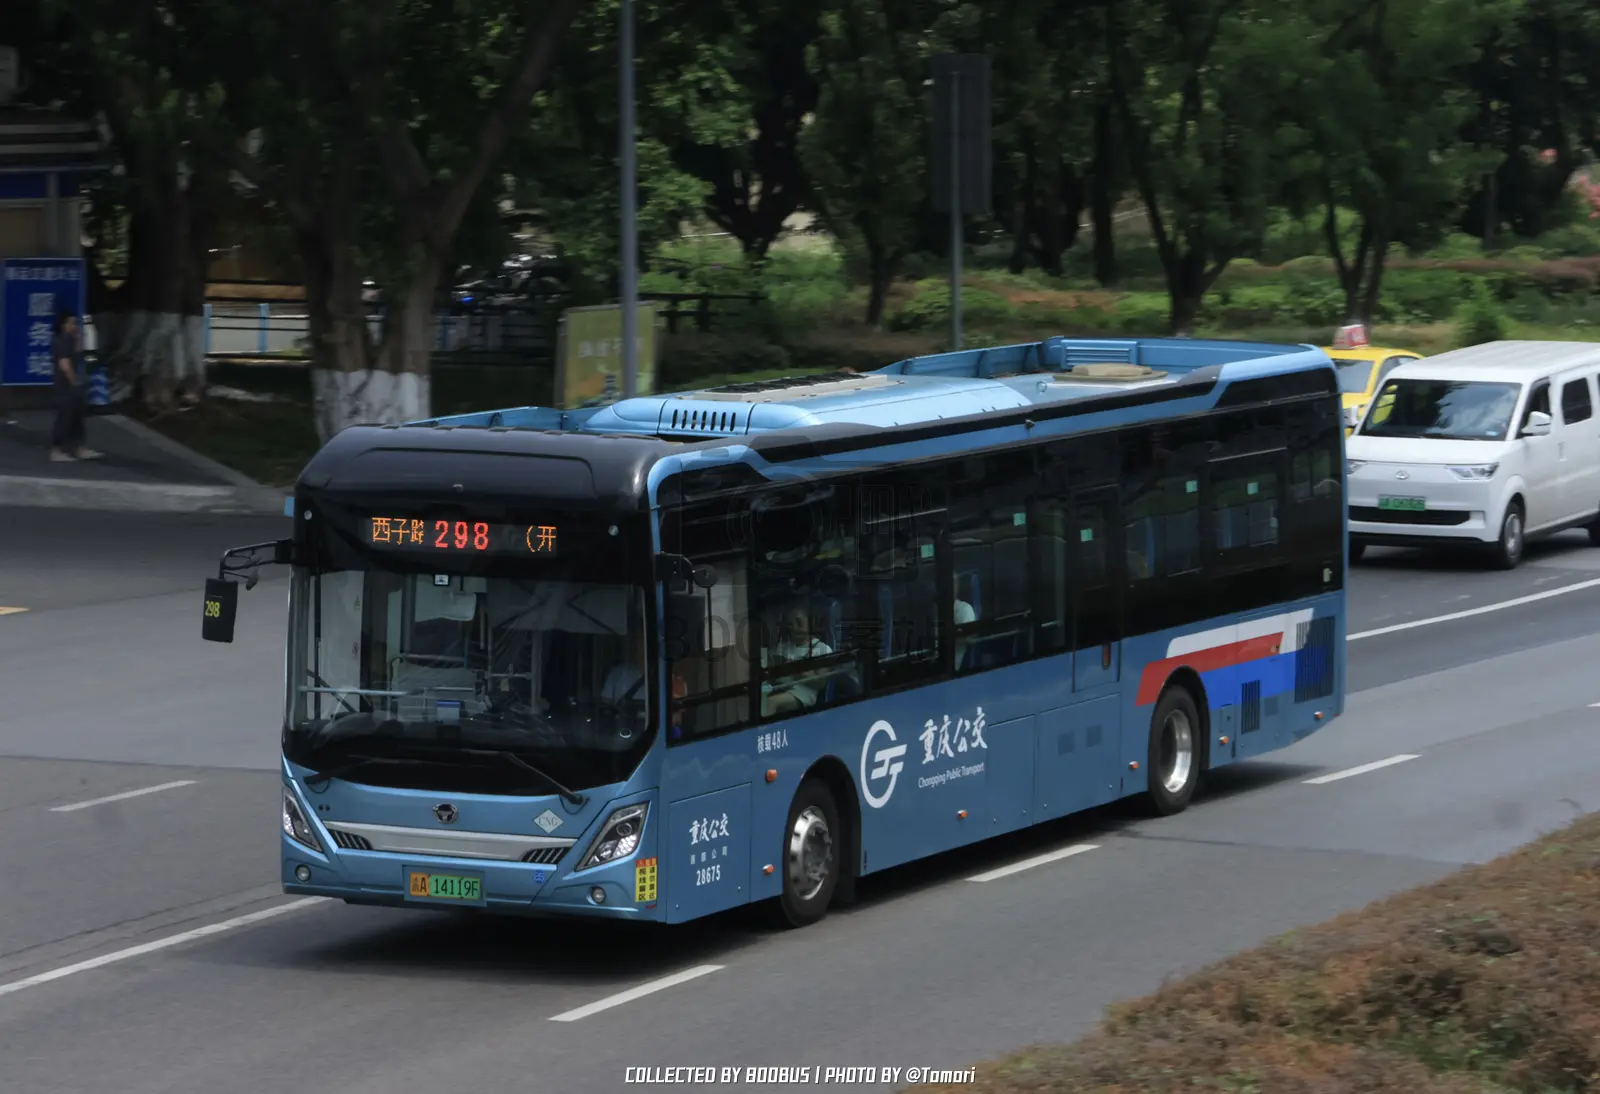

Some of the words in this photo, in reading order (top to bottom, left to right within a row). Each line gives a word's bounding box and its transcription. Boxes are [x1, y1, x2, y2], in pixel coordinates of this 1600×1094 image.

[434, 519, 490, 552] 298
[205, 600, 221, 618] 298
[918, 706, 988, 765] 重庆公交
[918, 773, 947, 789] Chongqing
[946, 769, 962, 781] Public
[961, 762, 985, 777] Transport
[689, 812, 730, 846] 重庆公交
[696, 864, 721, 886] 28675
